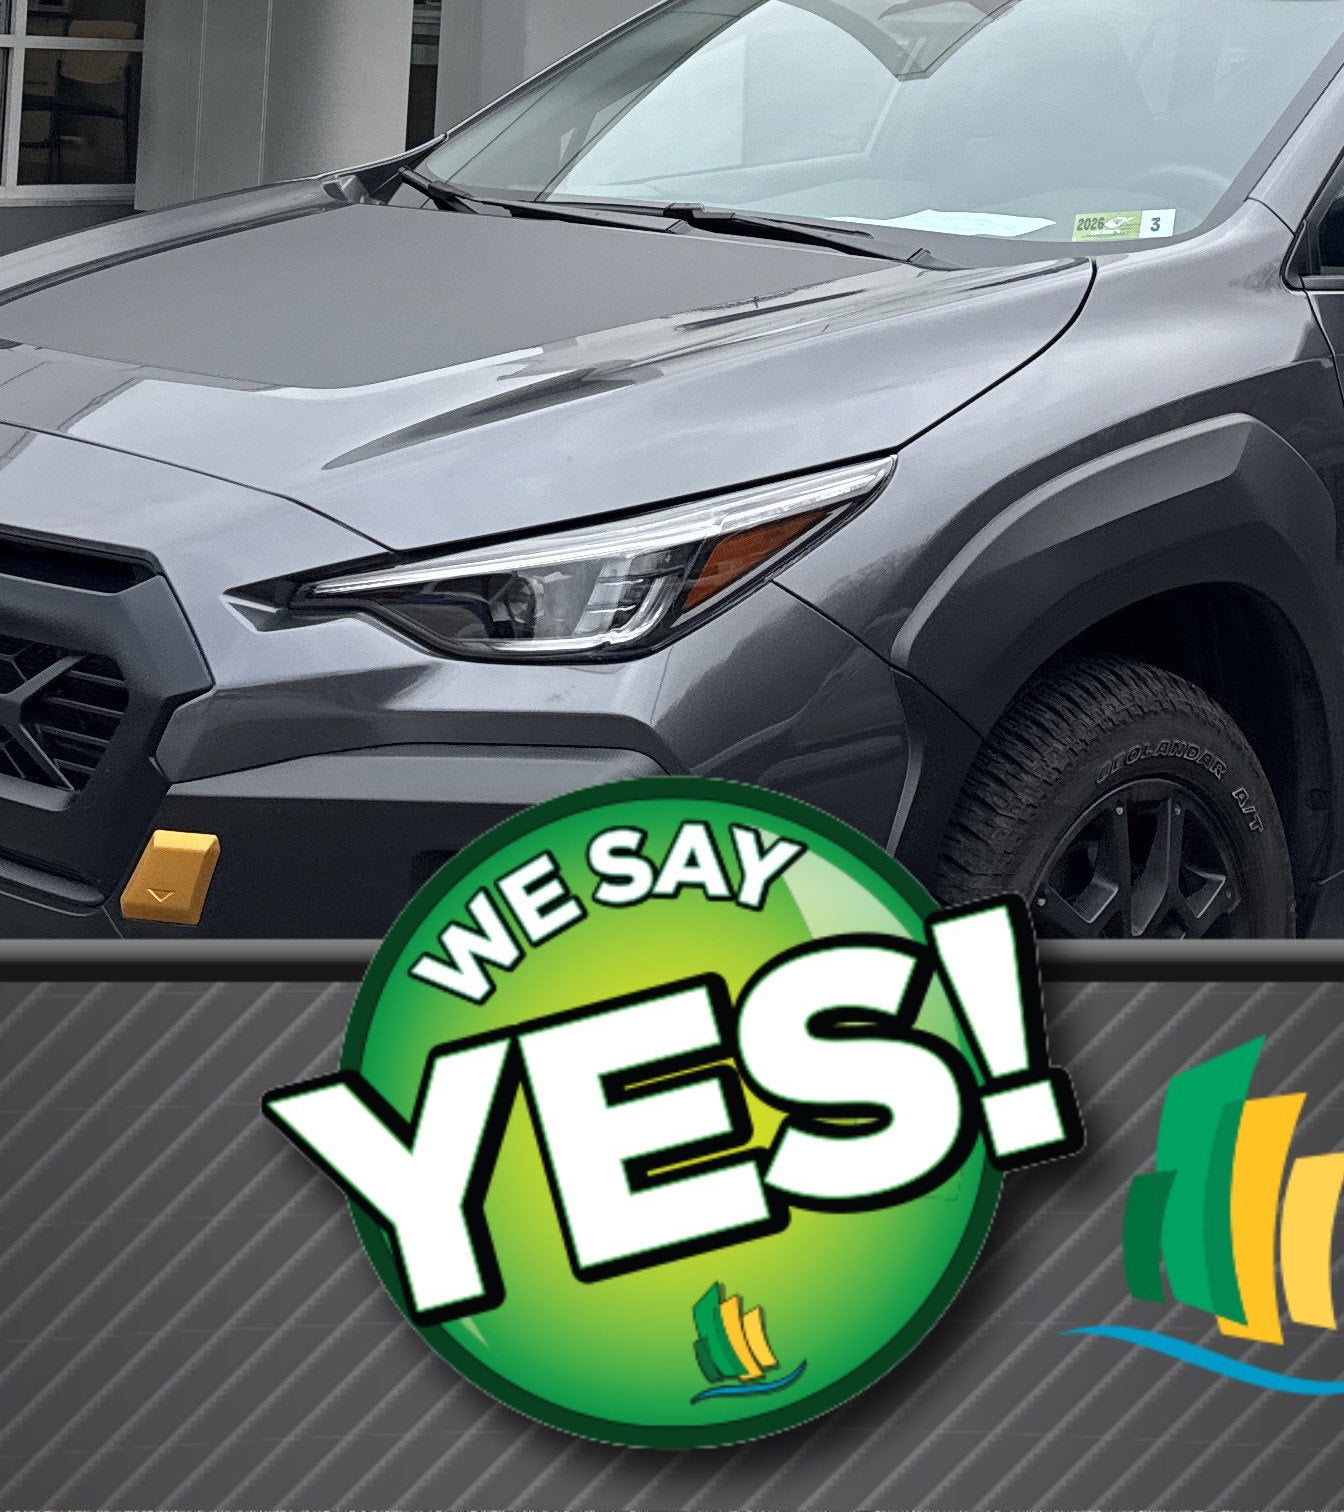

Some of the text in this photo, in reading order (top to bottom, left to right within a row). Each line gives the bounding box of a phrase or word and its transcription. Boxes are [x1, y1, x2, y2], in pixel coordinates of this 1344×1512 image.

[1076, 216, 1161, 232] 2026 3
[1231, 786, 1266, 833] A/T
